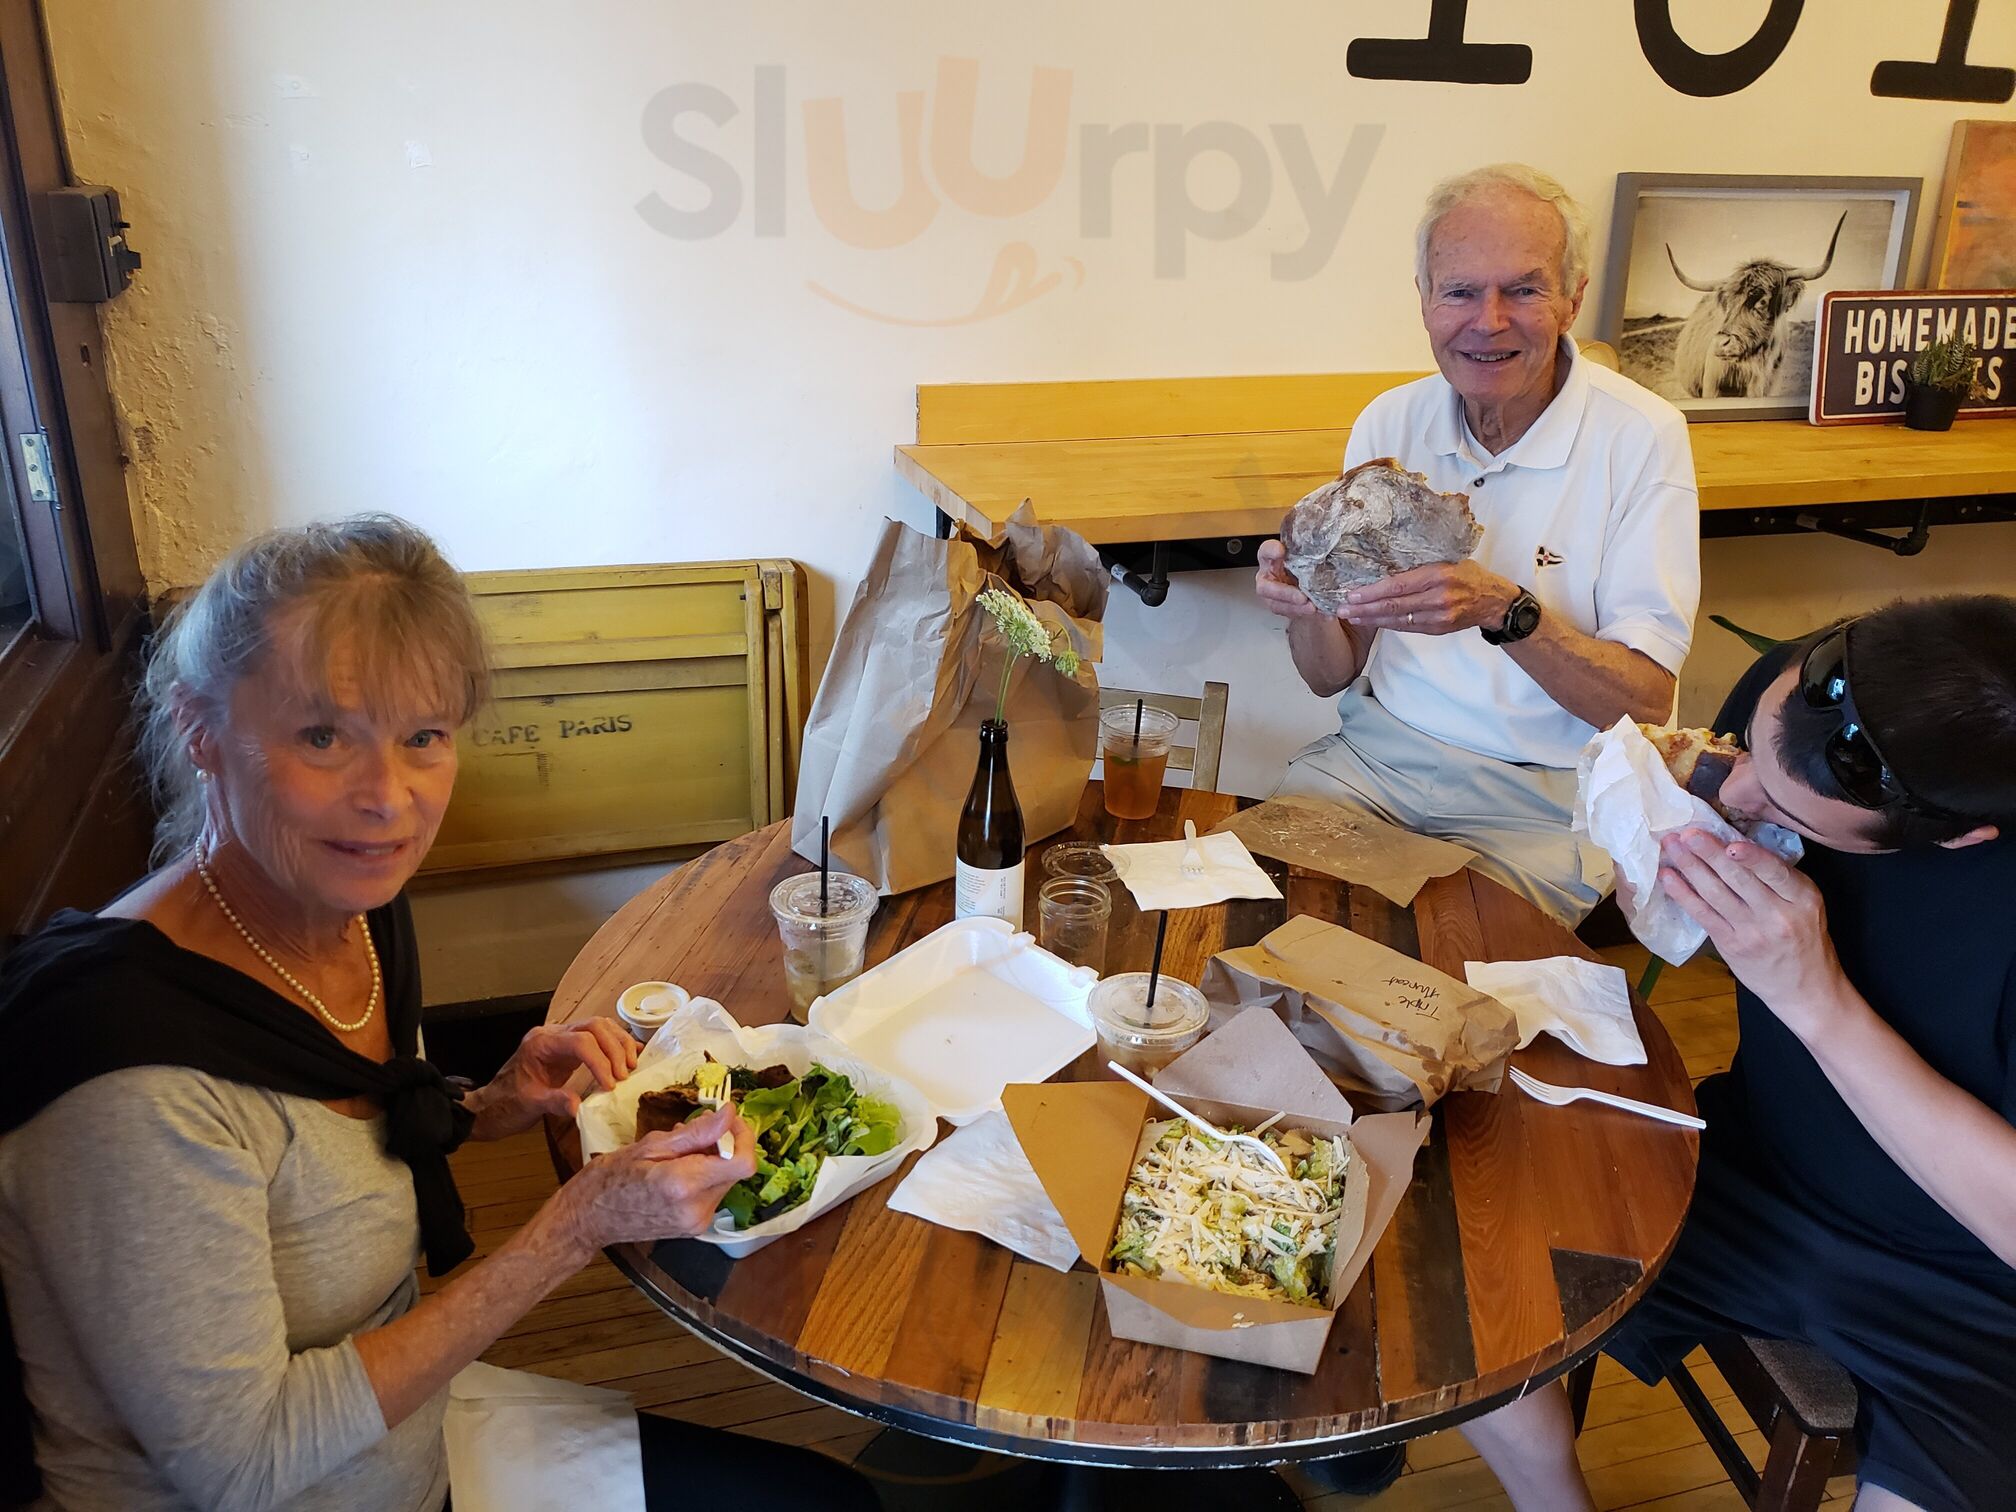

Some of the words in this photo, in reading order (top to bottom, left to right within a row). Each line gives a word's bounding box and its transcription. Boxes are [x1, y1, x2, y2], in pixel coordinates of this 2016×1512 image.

[1844, 306, 2016, 354] HOMEMADE
[472, 724, 541, 747] CAFE
[559, 714, 633, 738] PARIS
[1398, 995, 1440, 1021] Triple
